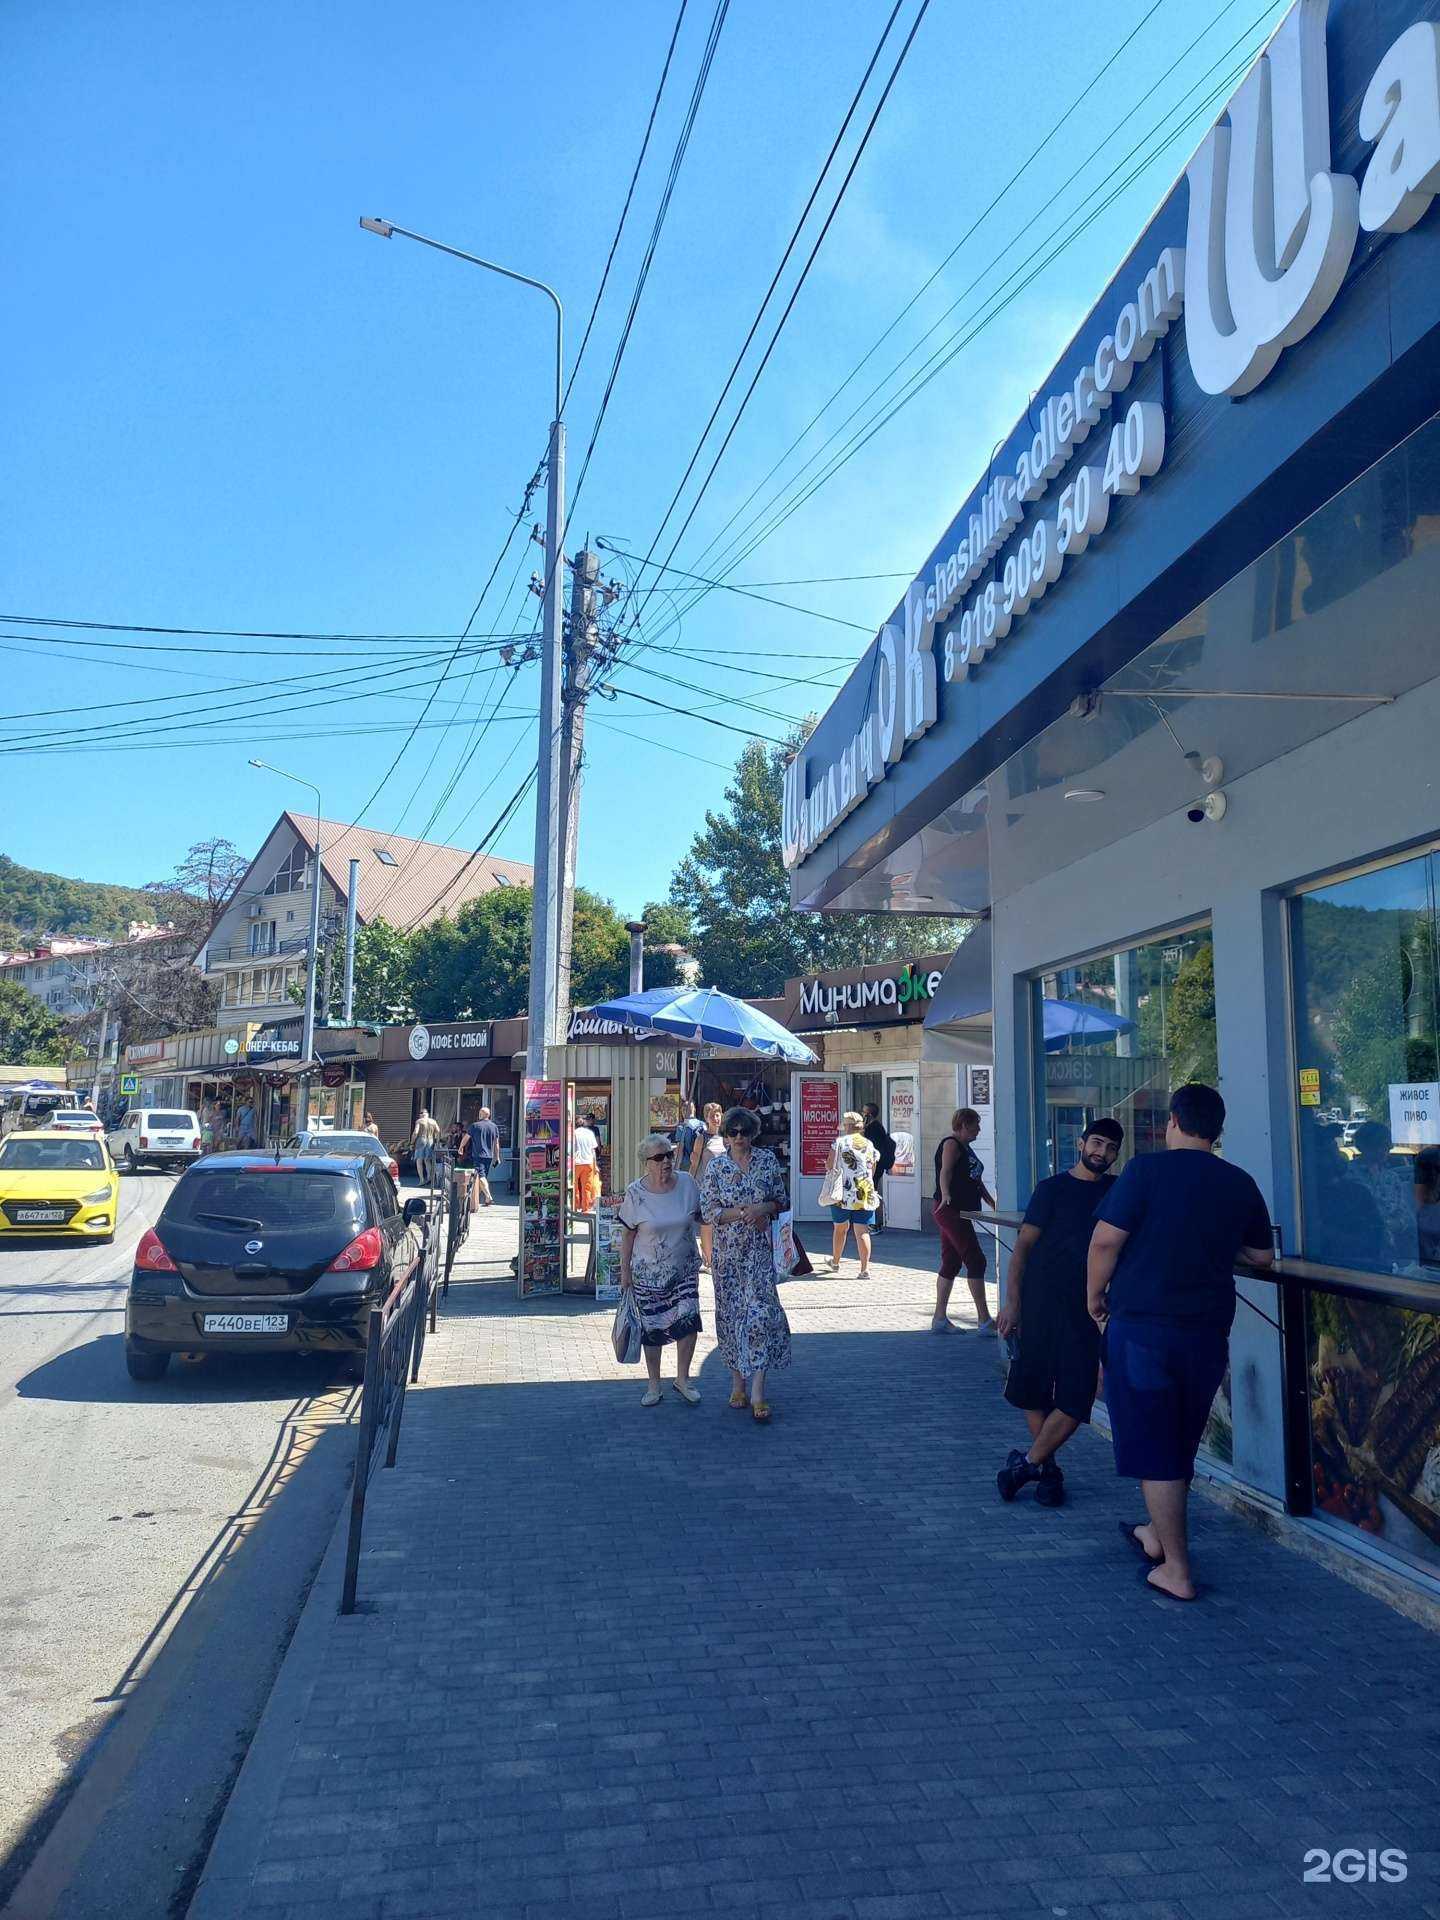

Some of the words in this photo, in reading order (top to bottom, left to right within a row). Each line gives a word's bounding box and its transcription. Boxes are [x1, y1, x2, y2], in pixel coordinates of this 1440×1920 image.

[926, 247, 1185, 622] shashlik-adler.com
[961, 582, 1003, 663] 918
[1003, 520, 1054, 614] 909
[1057, 466, 1099, 554] 50
[1103, 401, 1155, 494] 40
[431, 1035, 452, 1049] КОФЕ
[454, 1034, 460, 1048] С
[461, 1029, 487, 1048] СОБОЙ
[240, 1040, 299, 1053] ДОНЕР-КЕБАБ
[892, 1095, 914, 1105] МЯСО
[1400, 1089, 1430, 1101] ЖИВОЕ
[1404, 1111, 1427, 1121] ПИВО
[264, 1316, 286, 1327] 123
